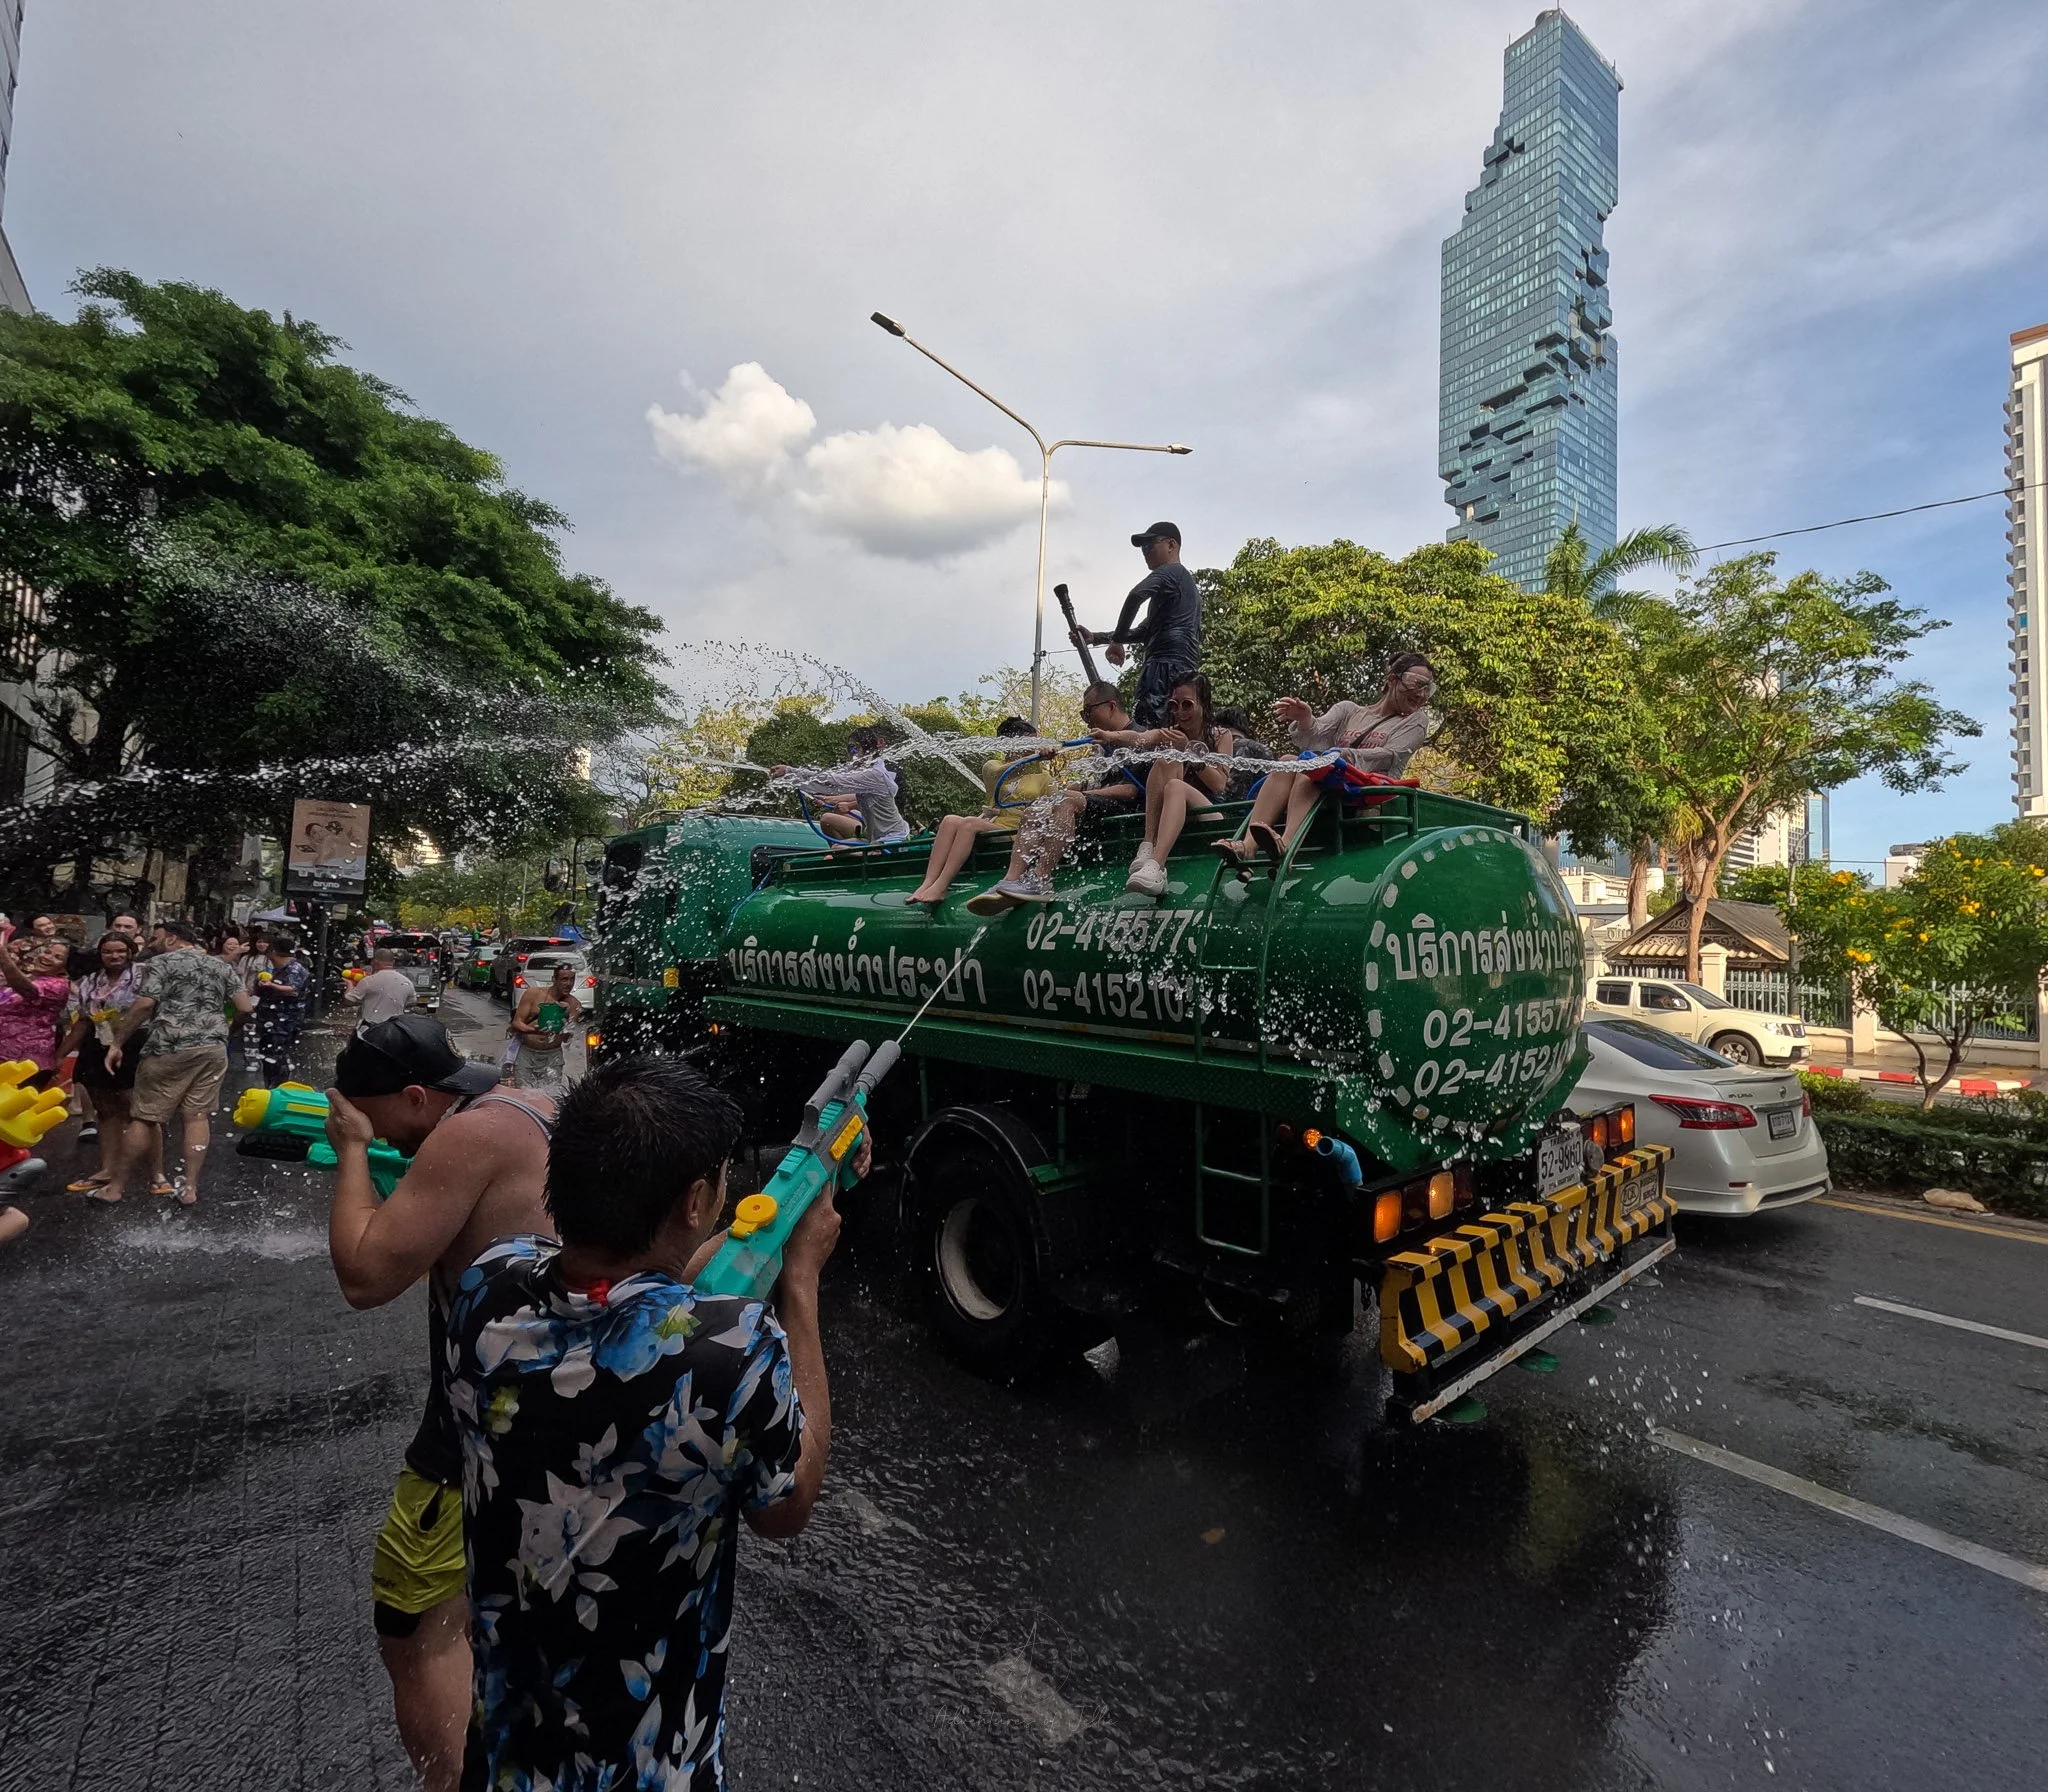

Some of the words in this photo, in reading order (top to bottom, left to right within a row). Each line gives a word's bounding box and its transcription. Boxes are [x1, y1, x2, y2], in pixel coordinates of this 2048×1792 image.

[729, 917, 987, 1004] บริการส่งน้ำประปา
[1541, 1141, 1580, 1180] 52-9860
